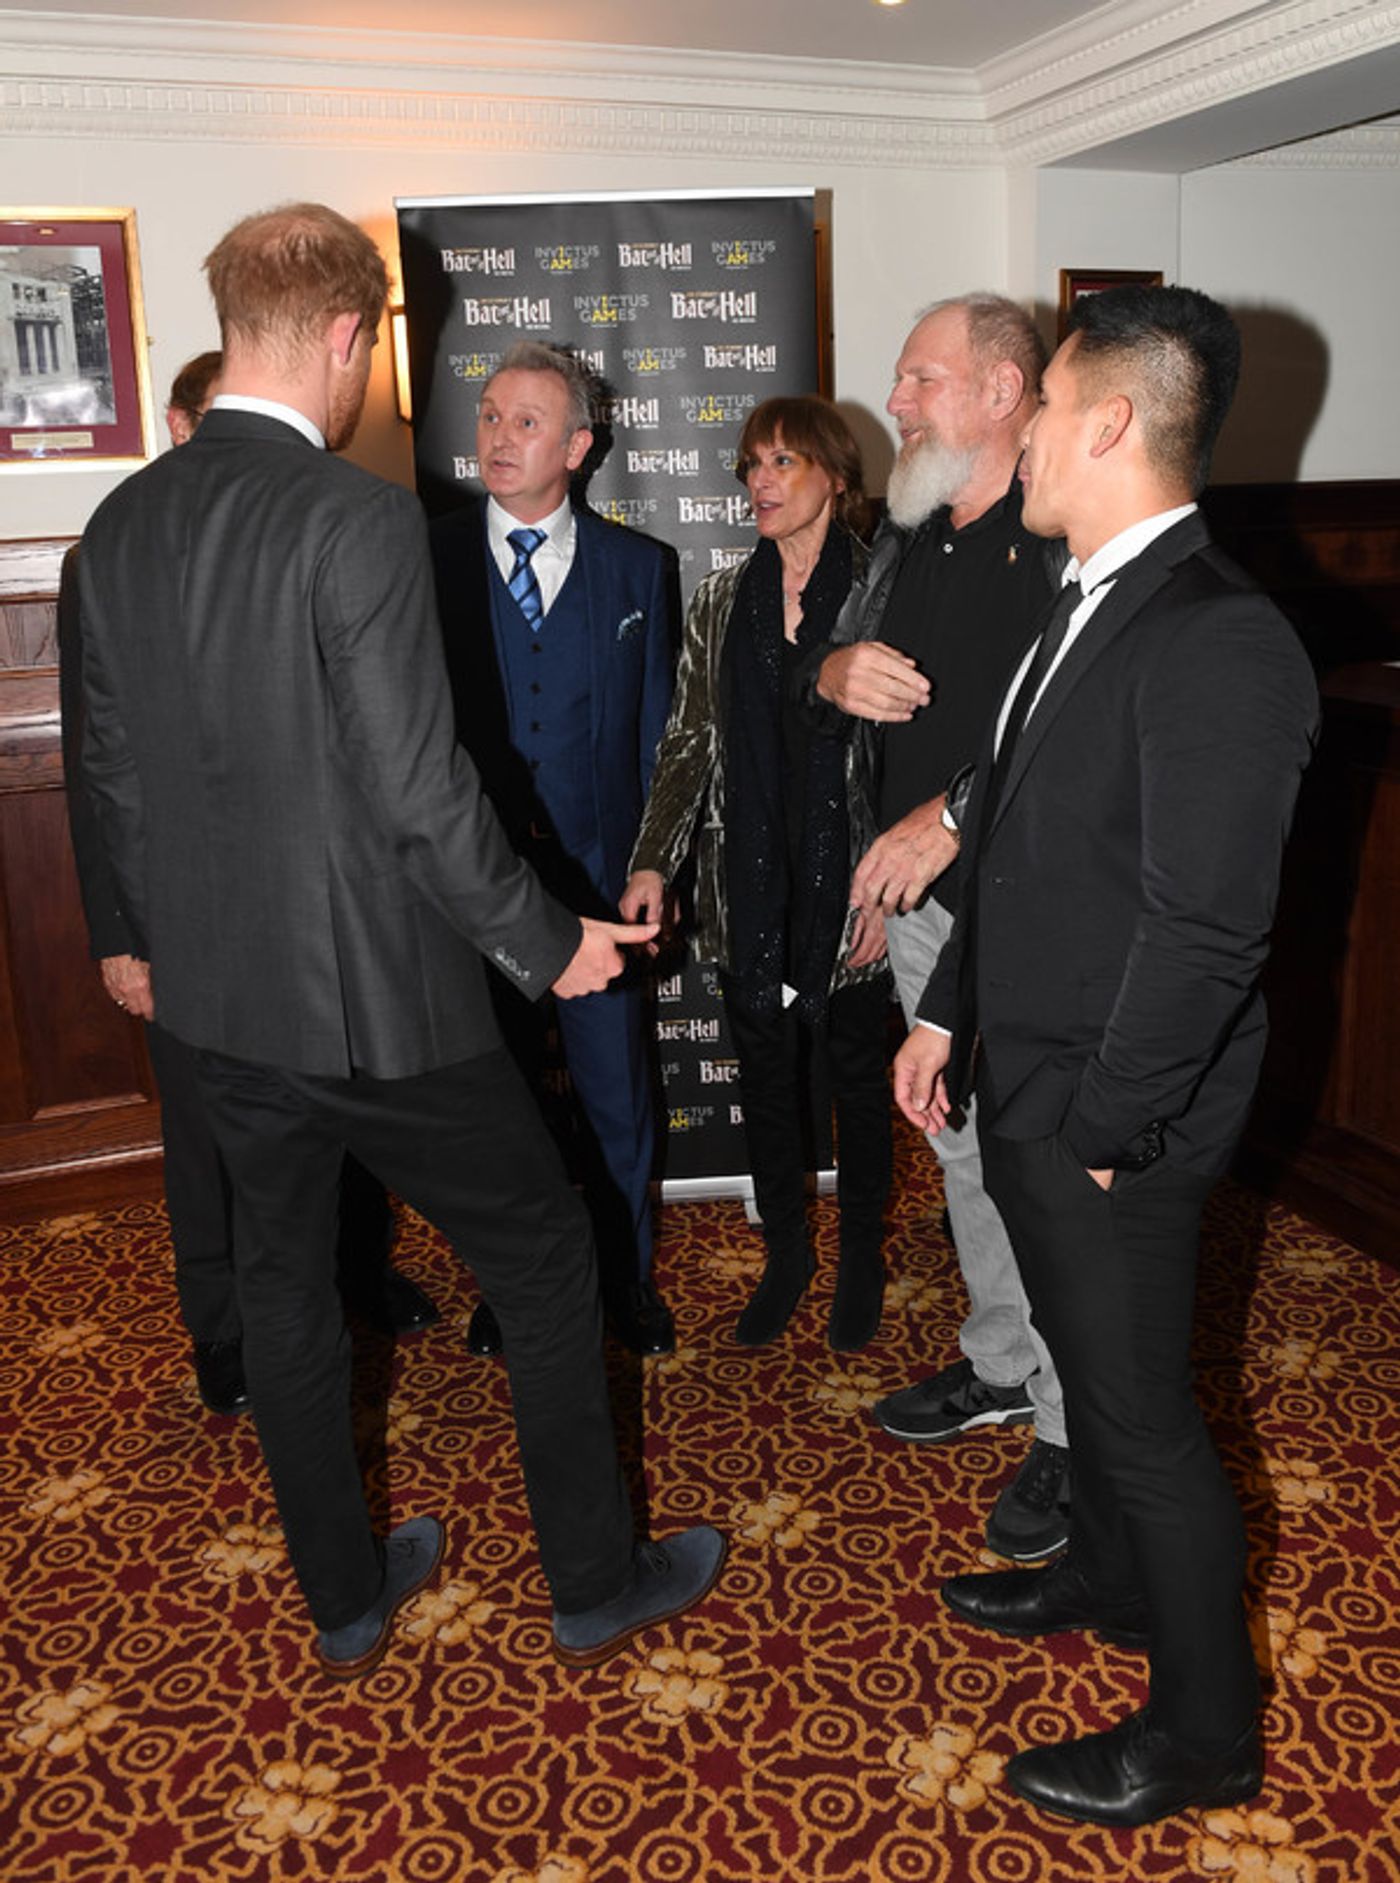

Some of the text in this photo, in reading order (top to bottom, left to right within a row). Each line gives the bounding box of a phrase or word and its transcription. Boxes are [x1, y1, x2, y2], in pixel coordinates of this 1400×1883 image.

[535, 245, 600, 259] INVICTUS
[711, 240, 777, 254] INVICTUS
[483, 247, 515, 275] Hell
[540, 257, 590, 270] GAMES
[660, 242, 693, 270] Hell
[716, 252, 766, 266] GAMES
[574, 294, 649, 309] INVICTUS
[720, 290, 758, 322] Hell
[514, 296, 552, 328] Hell
[579, 307, 637, 322] GAMES
[623, 346, 687, 360] INVICTUS
[746, 344, 777, 371] Hell
[628, 358, 677, 371] GAMES
[681, 394, 756, 409] INVICTUS
[622, 397, 660, 428] Hell
[686, 407, 744, 423] GAMES
[668, 448, 700, 475] Hell
[587, 498, 658, 513] NVICTUS
[690, 1019, 719, 1042] Hell
[668, 1116, 705, 1129] AMES
